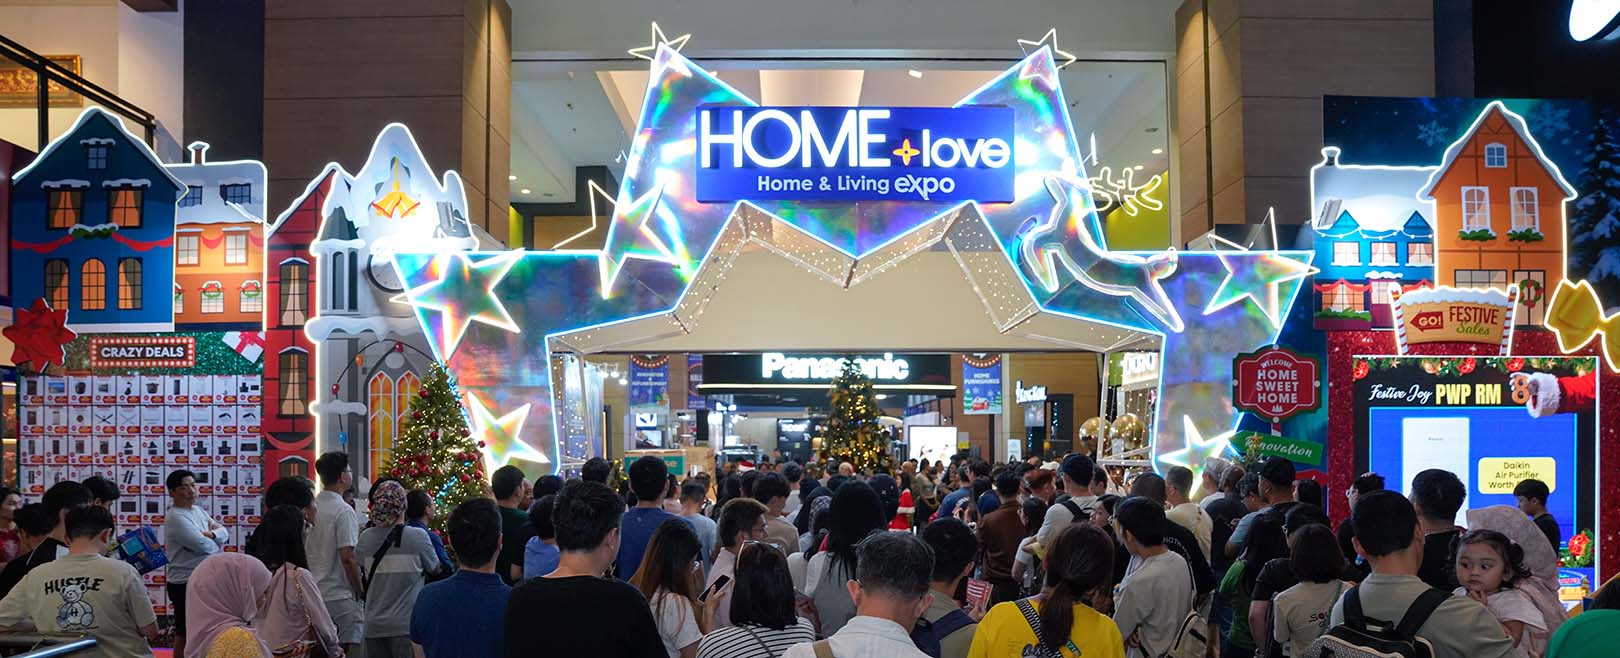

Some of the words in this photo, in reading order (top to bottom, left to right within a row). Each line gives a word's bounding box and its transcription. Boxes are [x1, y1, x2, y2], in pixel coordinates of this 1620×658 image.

[701, 109, 891, 168] HOME
[922, 129, 1011, 168] love
[757, 175, 813, 191] Home
[819, 176, 832, 191] &
[837, 175, 890, 195] Living
[894, 174, 956, 200] expo
[1449, 305, 1499, 325] FESTIVE
[1418, 316, 1442, 327] GO!
[1456, 321, 1490, 336] Sales
[101, 347, 143, 358] CRAZY
[146, 347, 184, 358] DEALS
[1260, 359, 1293, 369] WELCOME
[1257, 370, 1298, 380] HOME
[1256, 381, 1299, 392] SWEET
[1257, 393, 1298, 403] HOME
[1368, 384, 1406, 400] Festive
[1406, 384, 1433, 404] Joy
[1435, 384, 1472, 404] PWP
[1475, 384, 1502, 404] RM
[1503, 461, 1531, 470] Daikin
[1495, 471, 1508, 479] Air
[1508, 471, 1540, 479] Purifier
[1488, 481, 1515, 489] Worth
[44, 577, 105, 595] HUSTLE
